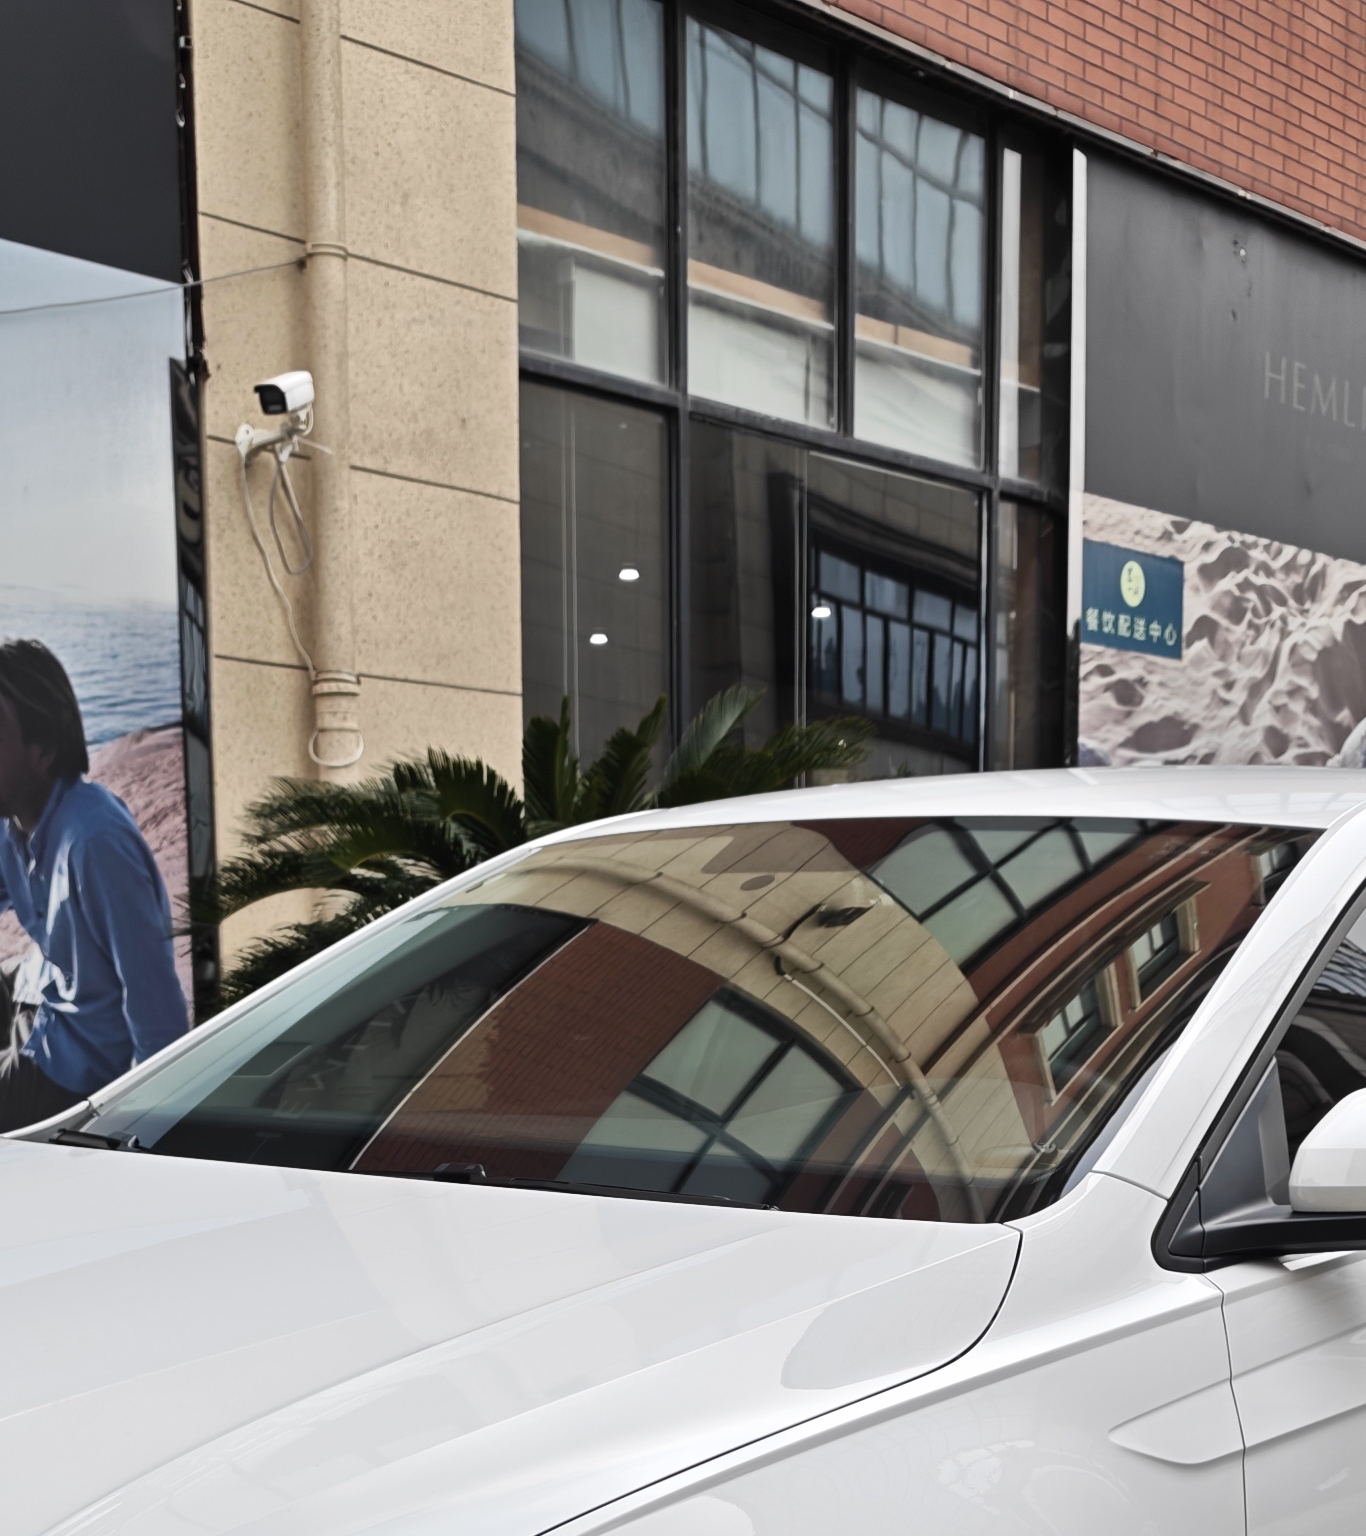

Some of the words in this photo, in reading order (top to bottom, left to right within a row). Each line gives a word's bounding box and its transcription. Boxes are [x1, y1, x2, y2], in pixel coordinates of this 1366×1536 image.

[1085, 606, 1178, 647] 餐饮配送中心
